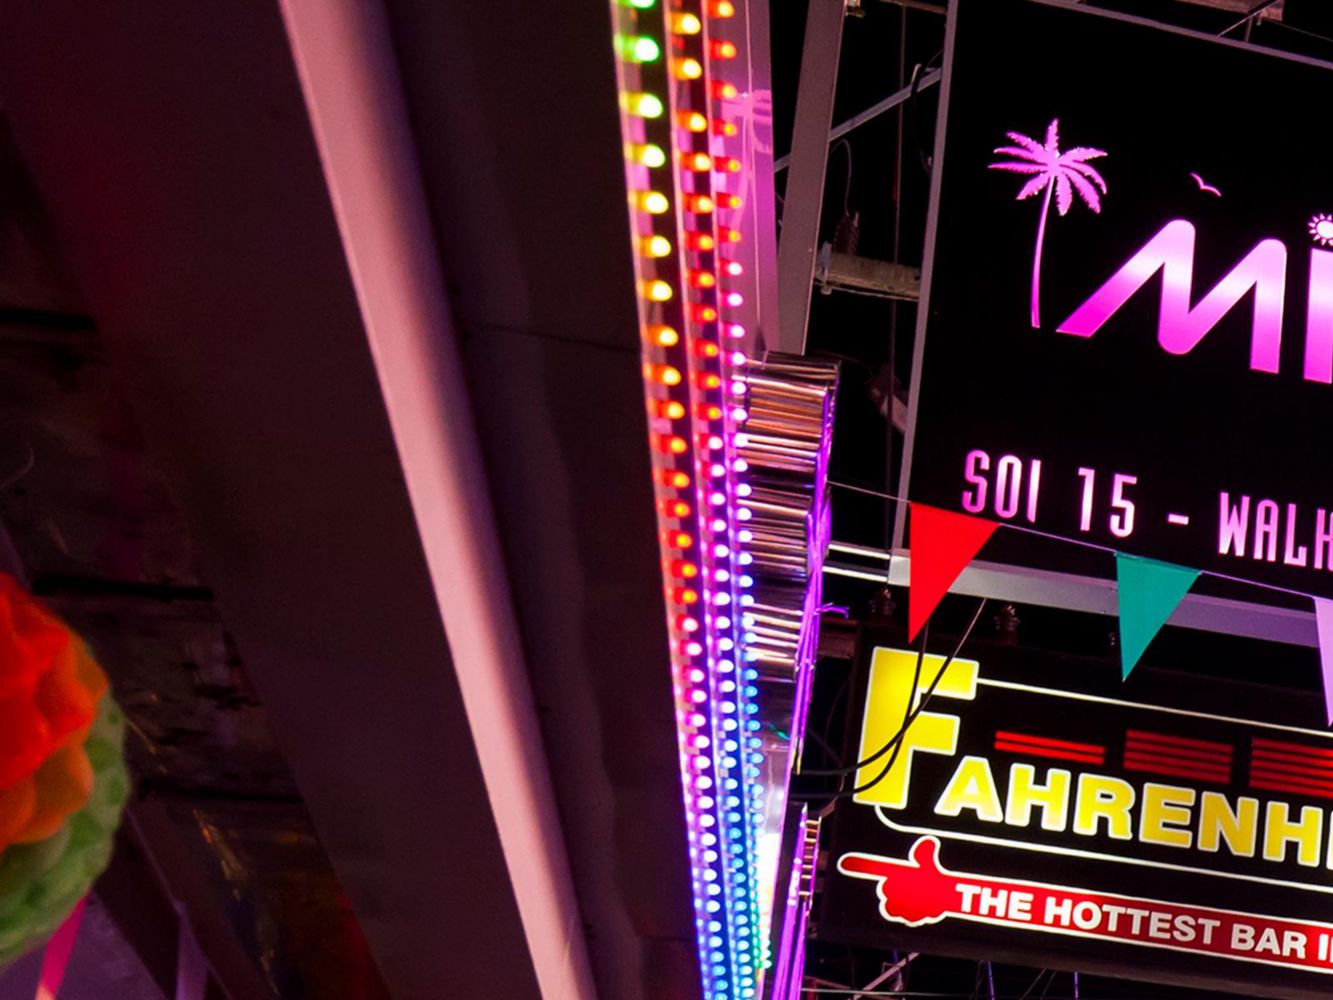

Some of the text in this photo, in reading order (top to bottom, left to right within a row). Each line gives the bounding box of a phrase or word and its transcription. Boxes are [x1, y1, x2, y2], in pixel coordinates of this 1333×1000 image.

[961, 450, 1041, 525] SOI
[1079, 466, 1139, 540] 15
[955, 881, 1035, 924] THE
[1043, 895, 1221, 947] HOTTEST
[1229, 923, 1307, 960] BAR
